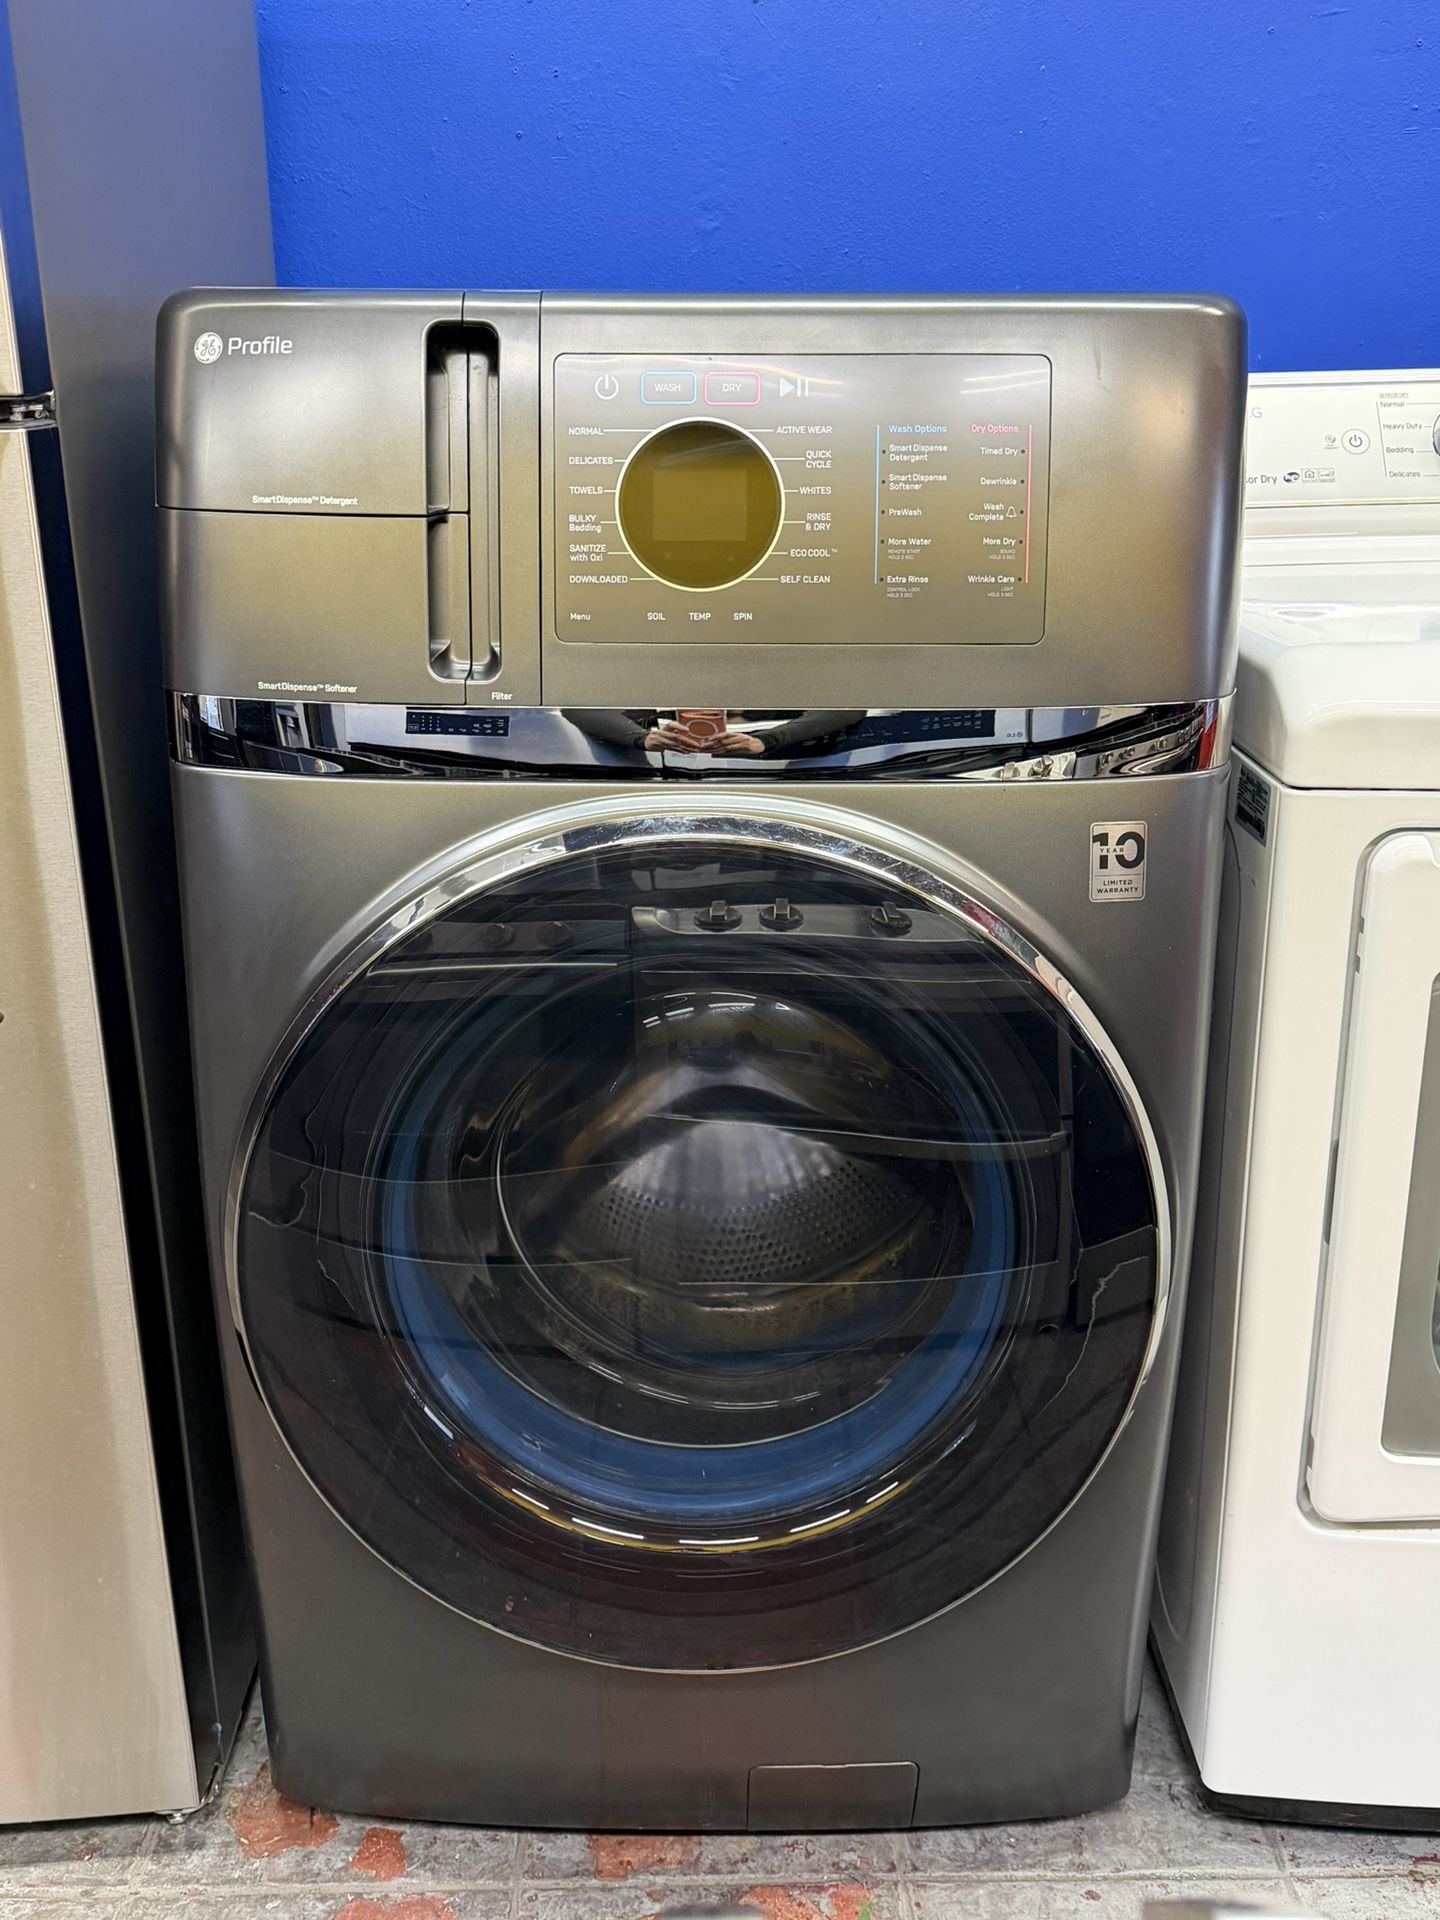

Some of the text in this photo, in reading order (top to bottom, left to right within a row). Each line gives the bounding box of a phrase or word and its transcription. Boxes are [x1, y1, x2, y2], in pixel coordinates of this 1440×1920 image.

[228, 336, 292, 356] Profile
[654, 383, 681, 392] WASH
[722, 383, 742, 392] DRY
[568, 427, 604, 436] NORMAL
[776, 426, 832, 434] ACTIVE WEAR
[888, 424, 947, 434] Wash Options
[972, 424, 1018, 434] Dry Options
[806, 450, 832, 459] QUICK
[981, 447, 1018, 456] Timed Dry
[889, 453, 928, 462] Detergent
[806, 460, 832, 468] CYCLE
[980, 477, 1017, 485] Dewrinkle
[1261, 474, 1277, 484] Dry
[569, 486, 603, 495] TOWELS
[800, 486, 831, 494] WHITES
[889, 482, 922, 490] Softener
[320, 496, 358, 507] Detergent
[888, 508, 922, 516] PreWash
[569, 514, 596, 523] BULKY
[807, 513, 831, 521] RINSE
[969, 513, 1004, 522] Complete
[569, 524, 601, 533] Bedding
[805, 523, 831, 531] & DRY
[983, 537, 1016, 546] More Dry
[570, 544, 607, 552] SANITIZE
[569, 575, 628, 583] DOWNLOADED
[780, 576, 831, 584] SELF CLEAN
[887, 575, 929, 583] Extra Rinse
[968, 575, 1015, 583] Wrinkle Care
[325, 684, 358, 693] Softener
[492, 691, 512, 700] Filter
[1093, 831, 1145, 869] 10
